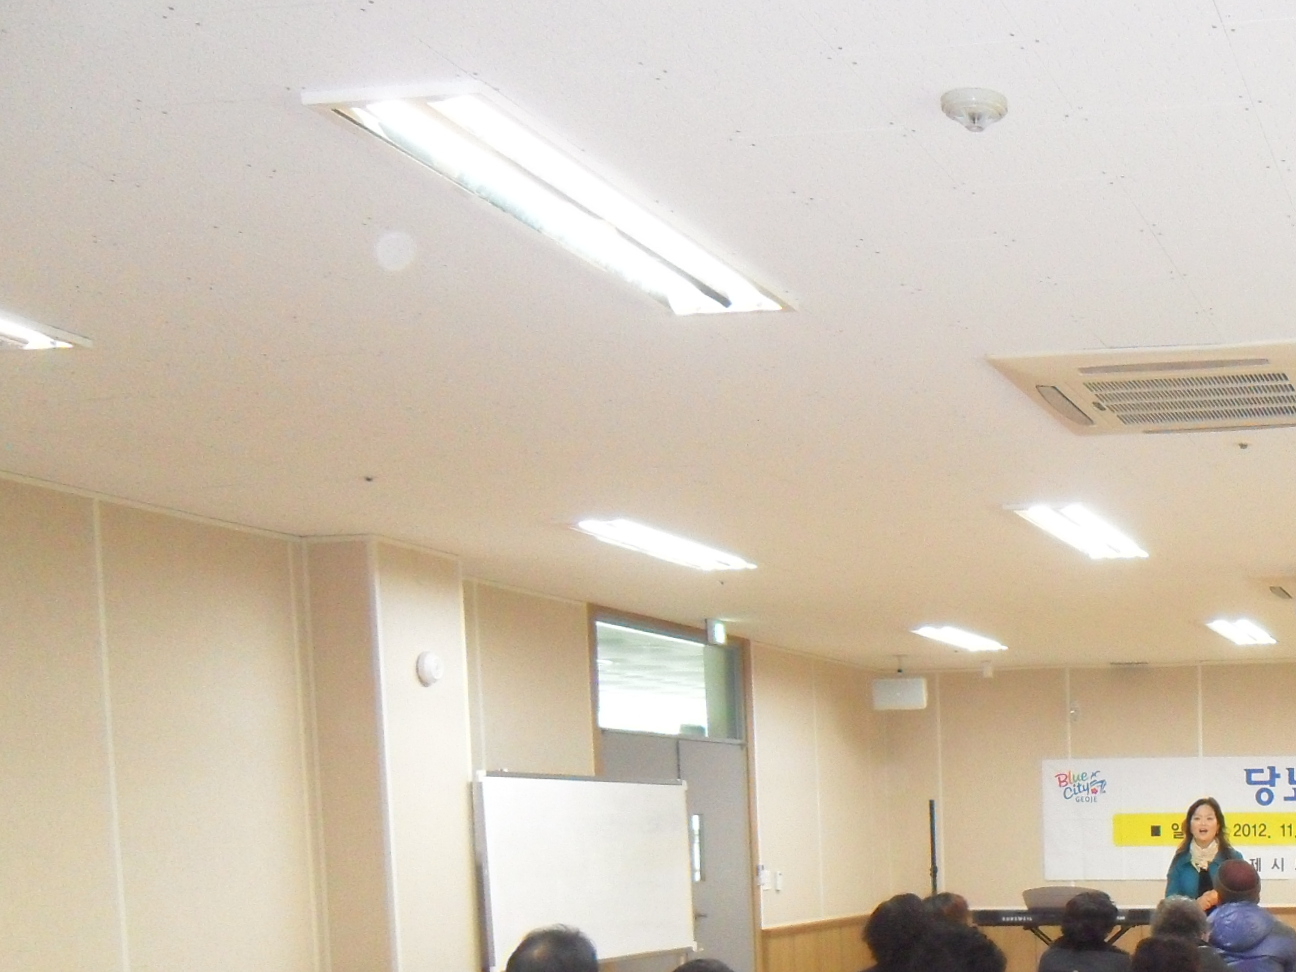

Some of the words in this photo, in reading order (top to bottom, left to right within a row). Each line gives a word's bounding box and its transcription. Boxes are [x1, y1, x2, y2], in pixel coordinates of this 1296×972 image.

[1055, 770, 1088, 787] Blue
[1063, 782, 1090, 800] City
[1233, 823, 1271, 838] 2012.
